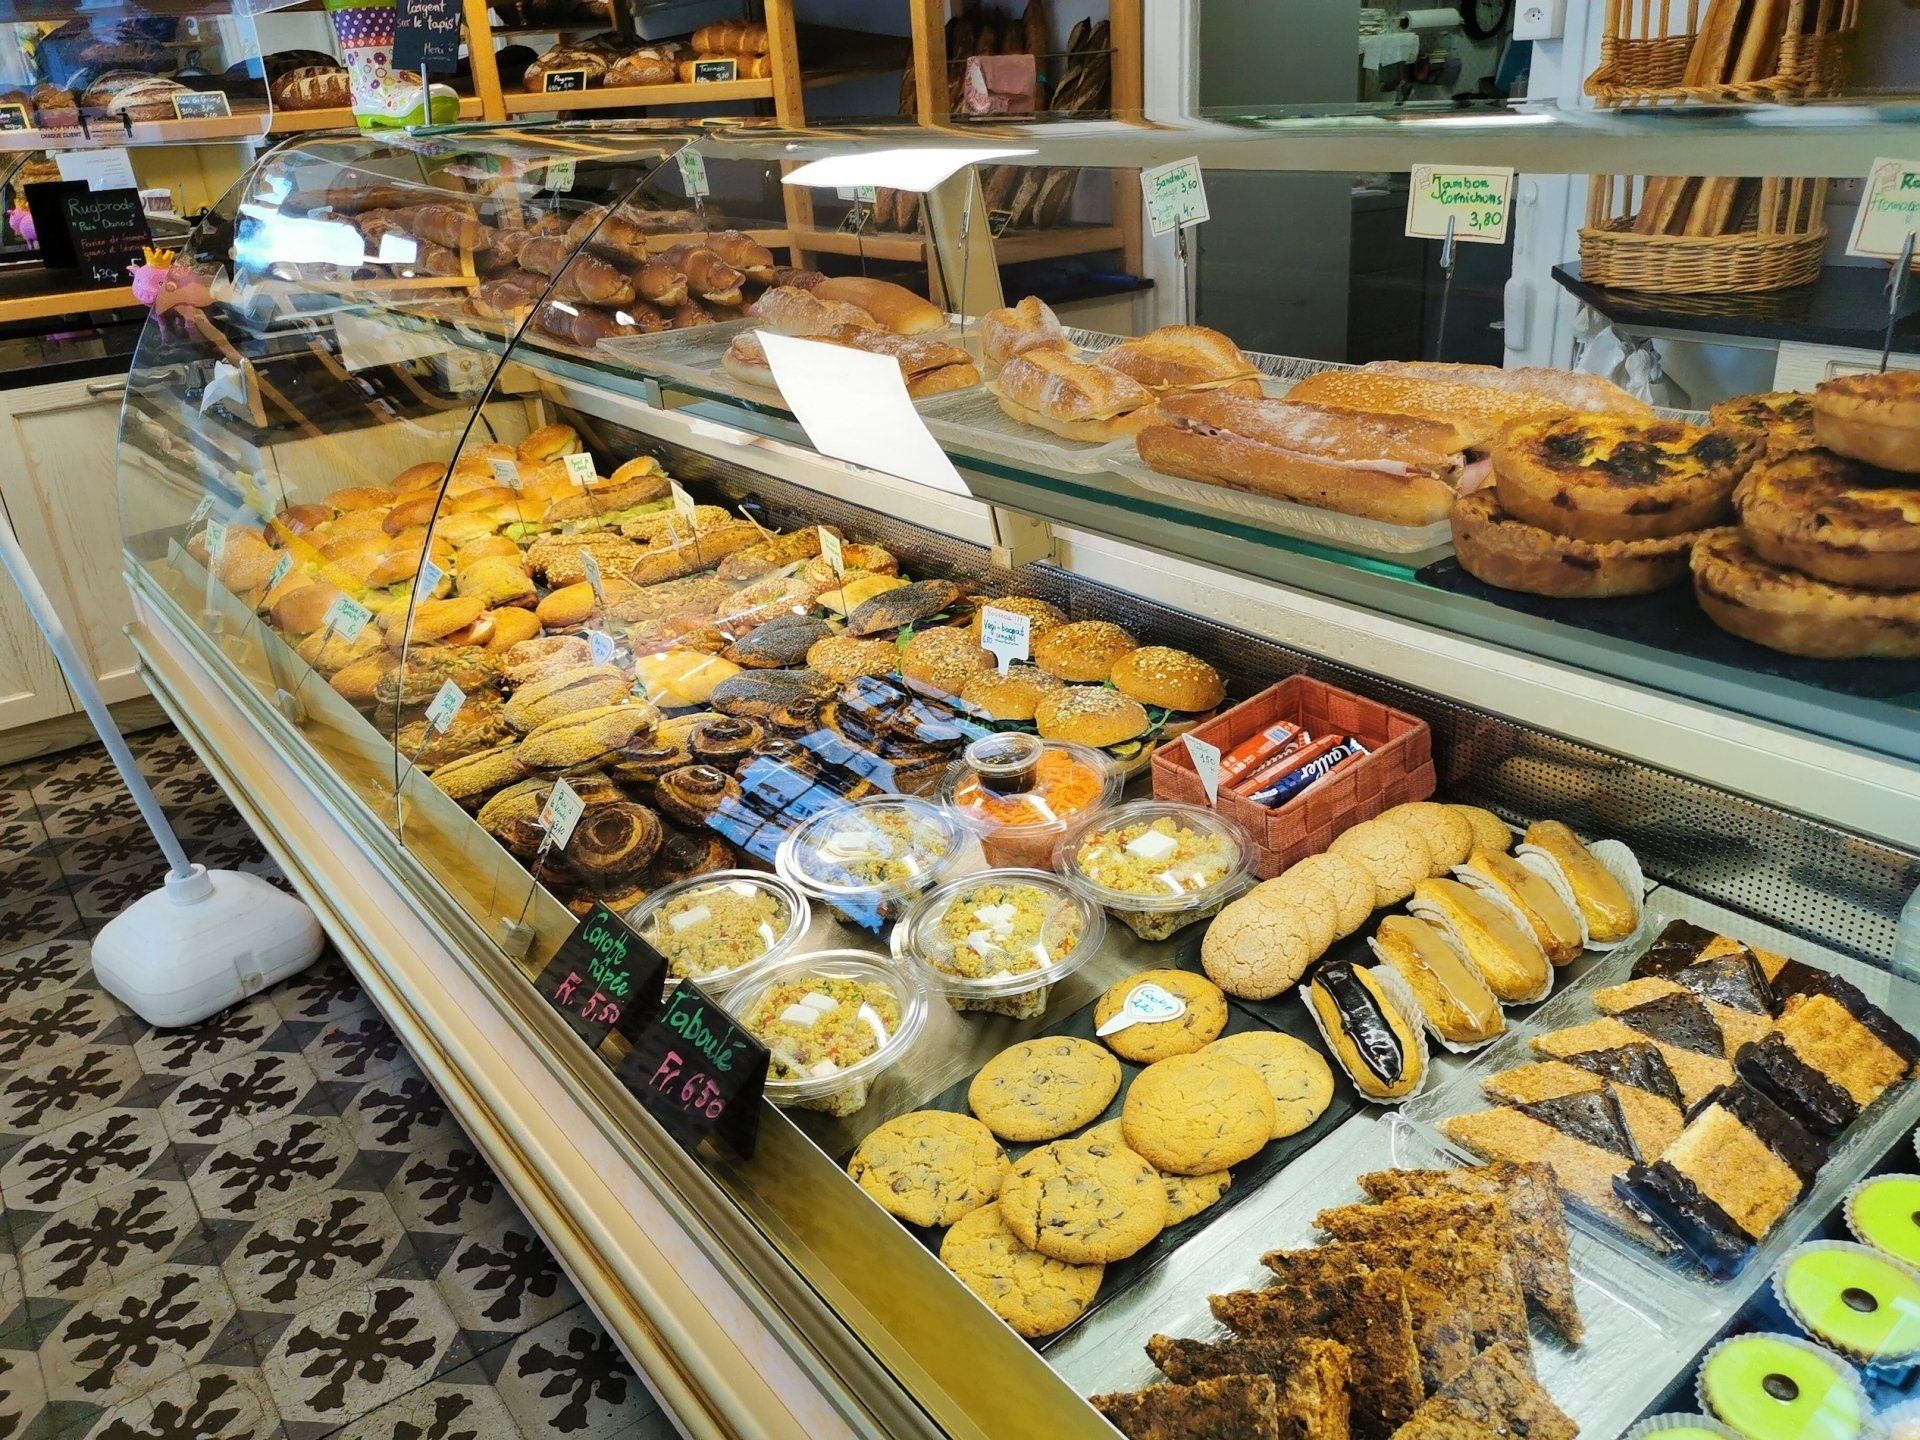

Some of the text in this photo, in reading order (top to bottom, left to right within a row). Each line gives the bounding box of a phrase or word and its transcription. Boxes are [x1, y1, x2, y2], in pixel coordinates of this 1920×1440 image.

[413, 15, 423, 28] le
[1181, 180, 1198, 195] 3,60
[1431, 176, 1489, 199] Jambon
[1440, 191, 1503, 204] Cornichons
[1469, 211, 1502, 230] 3,80
[1300, 745, 1352, 780] Cailler
[582, 912, 629, 965] Carotte
[554, 972, 621, 1024] Fr. 5,50
[660, 990, 746, 1072] Taboulé
[649, 1050, 726, 1119] Fr. 6,50
